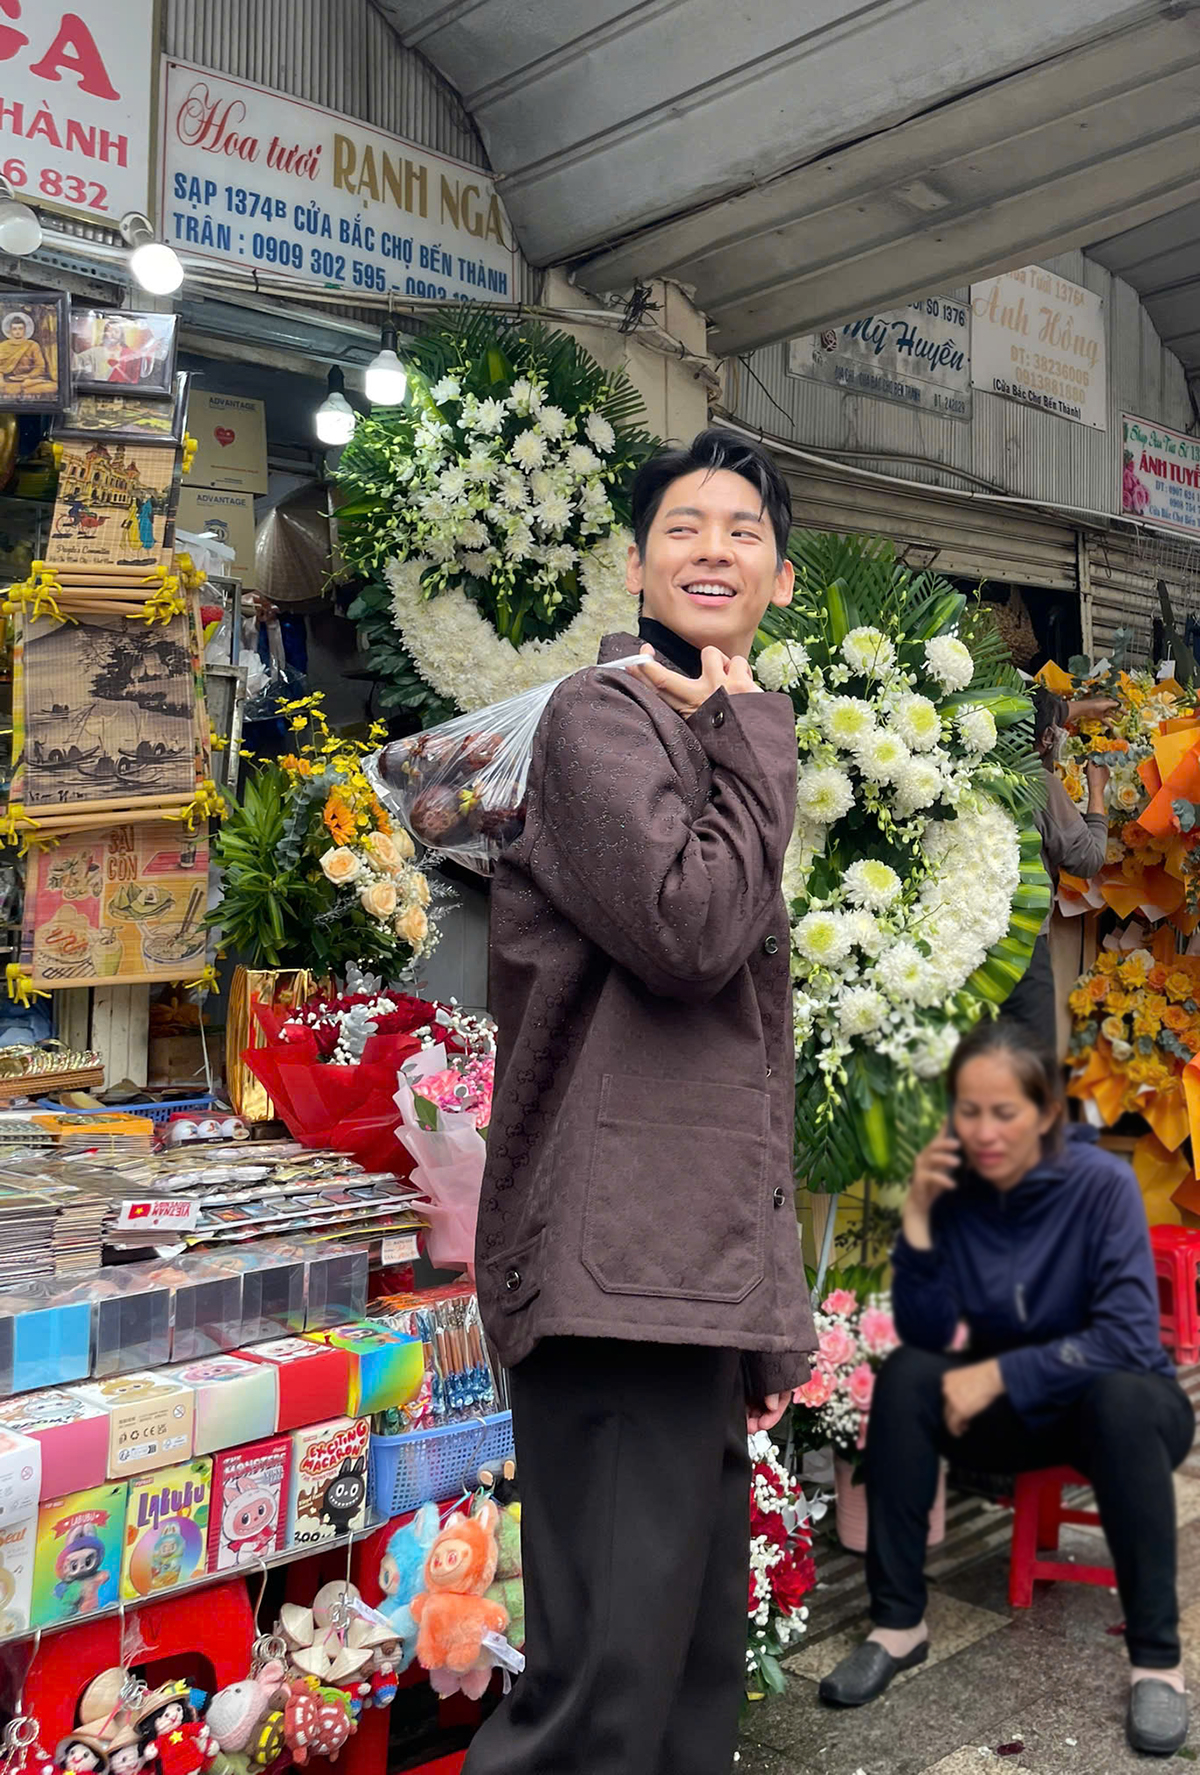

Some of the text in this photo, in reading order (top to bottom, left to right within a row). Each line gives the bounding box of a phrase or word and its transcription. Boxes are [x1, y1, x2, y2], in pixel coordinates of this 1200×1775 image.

[176, 82, 259, 163] Hoa
[266, 136, 321, 181] tươi
[333, 133, 427, 218] RẠNH
[39, 168, 109, 211] 832
[173, 212, 231, 252] TRÂN
[253, 232, 304, 270] 0909
[310, 248, 346, 281] 302
[352, 260, 386, 292] 595
[174, 172, 508, 296] SẠP 1374B CỬA BẮC CHỢ BẾN THÀNH
[943, 304, 966, 327] 1376
[891, 321, 965, 371] Huyền
[209, 396, 256, 411] ADVANTAGE
[1140, 449, 1167, 479] ÁNH
[197, 493, 246, 506] ADVANTAGE
[310, 1421, 367, 1458] EXCITING
[303, 1445, 360, 1472] MACARON
